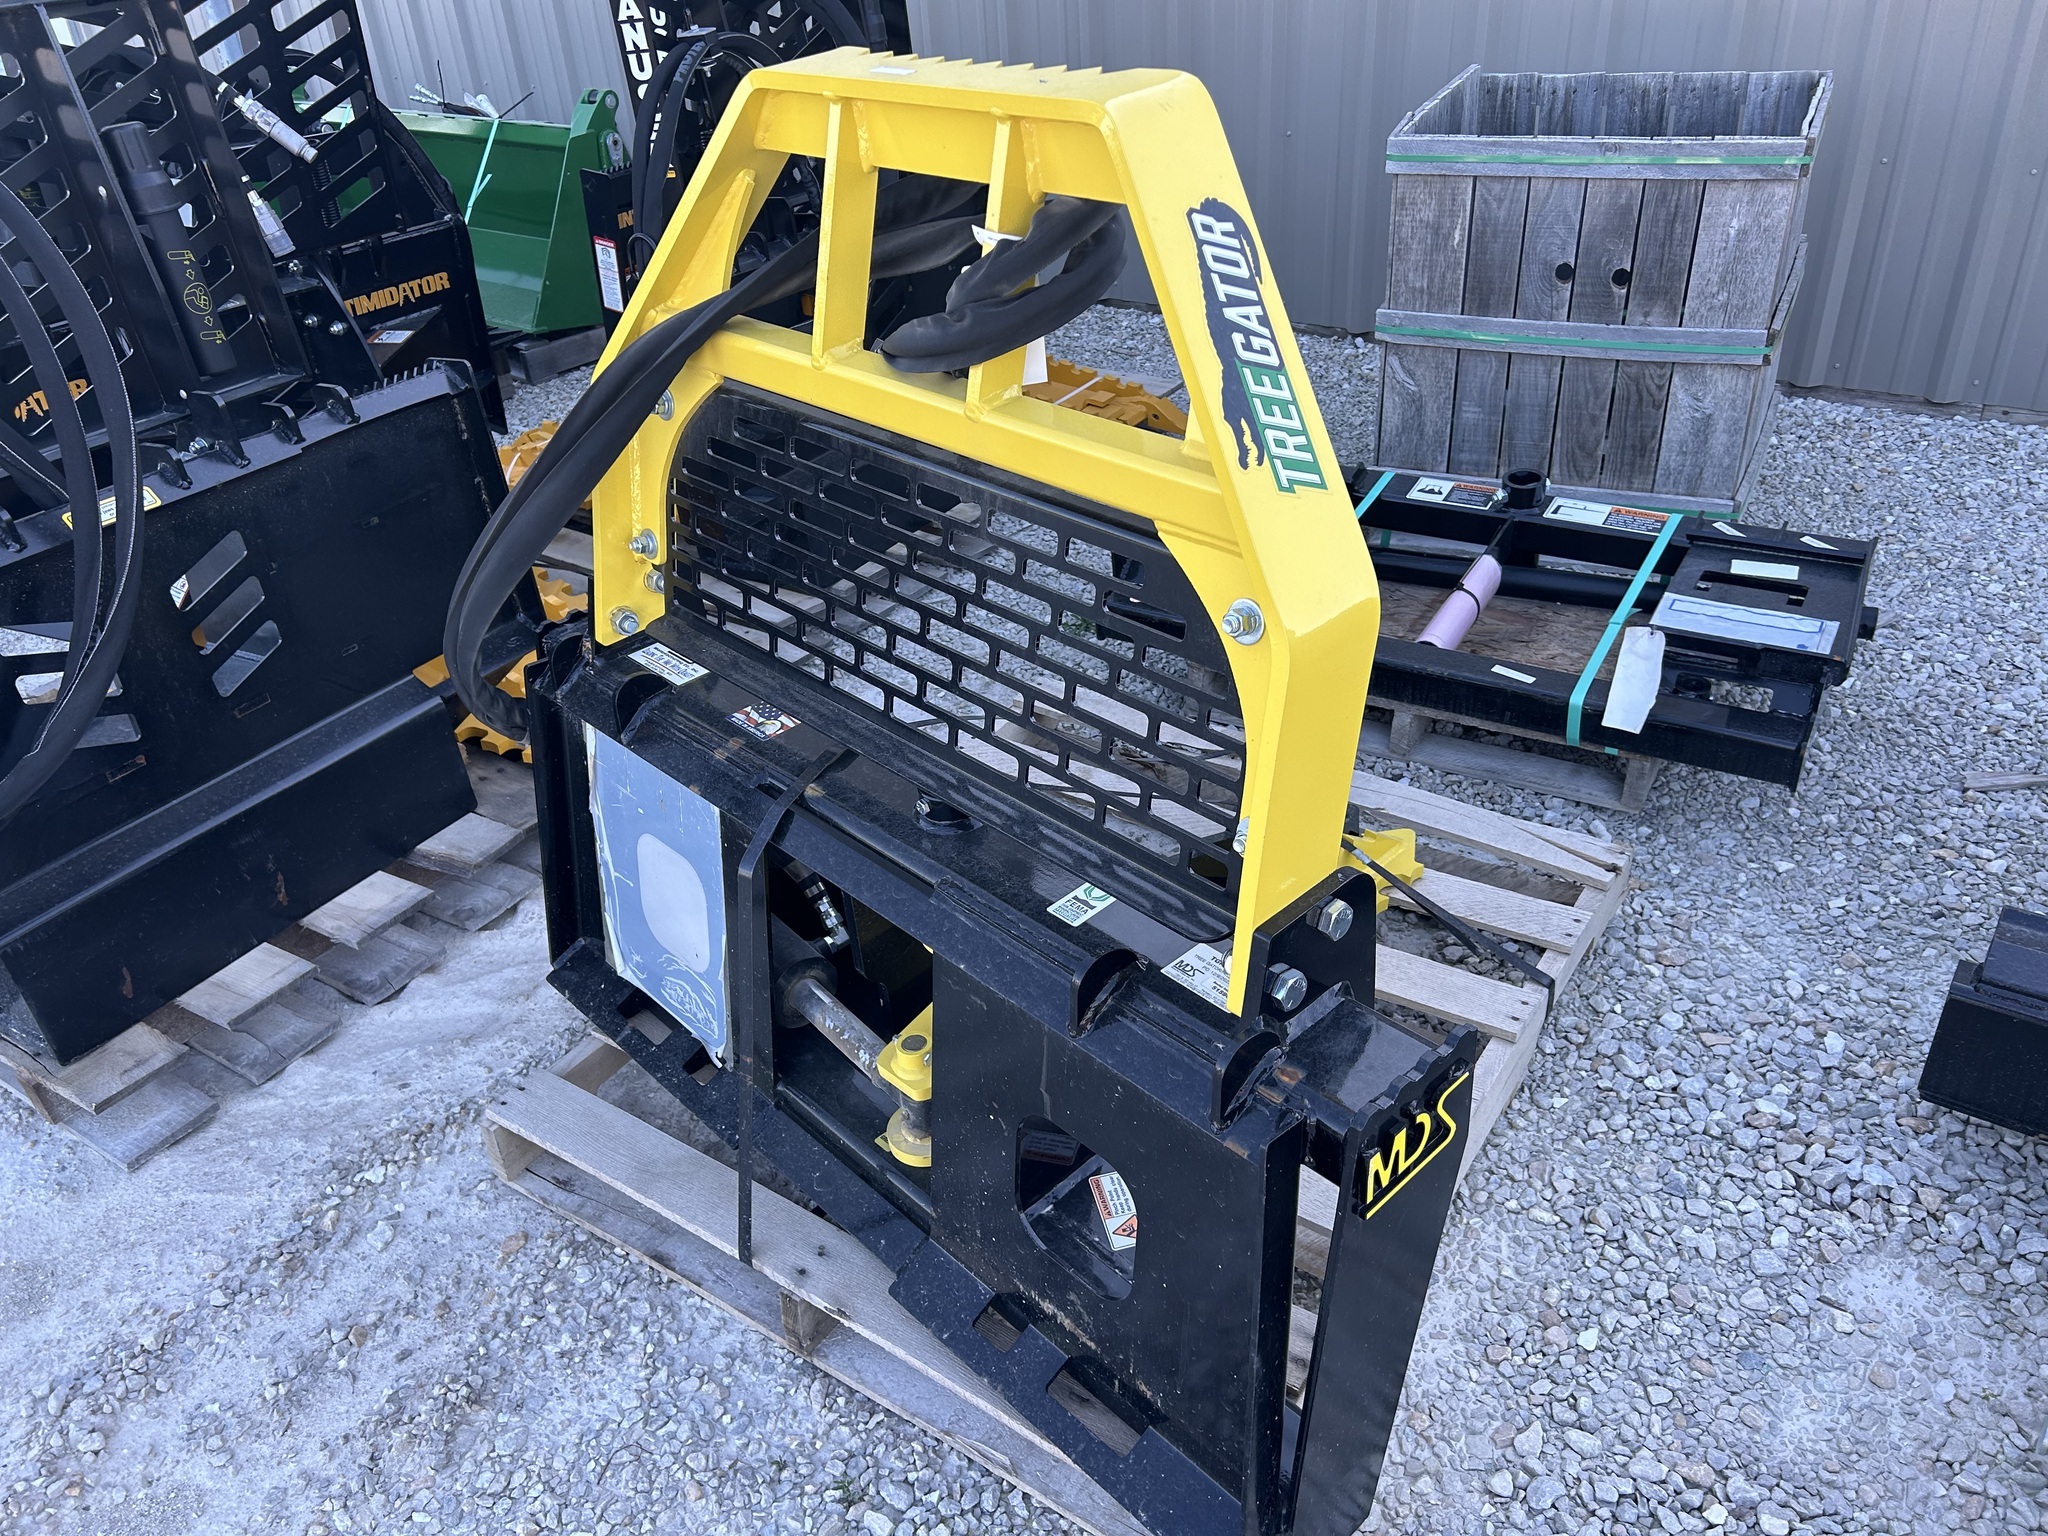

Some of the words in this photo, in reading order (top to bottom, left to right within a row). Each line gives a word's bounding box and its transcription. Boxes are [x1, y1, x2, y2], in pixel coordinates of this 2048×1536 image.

[617, 209, 634, 229] IN
[1065, 899, 1089, 915] FEMA
[1173, 959, 1205, 978] MDS
[1366, 1072, 1470, 1220] MDS
[1094, 1179, 1109, 1211] WARNING
